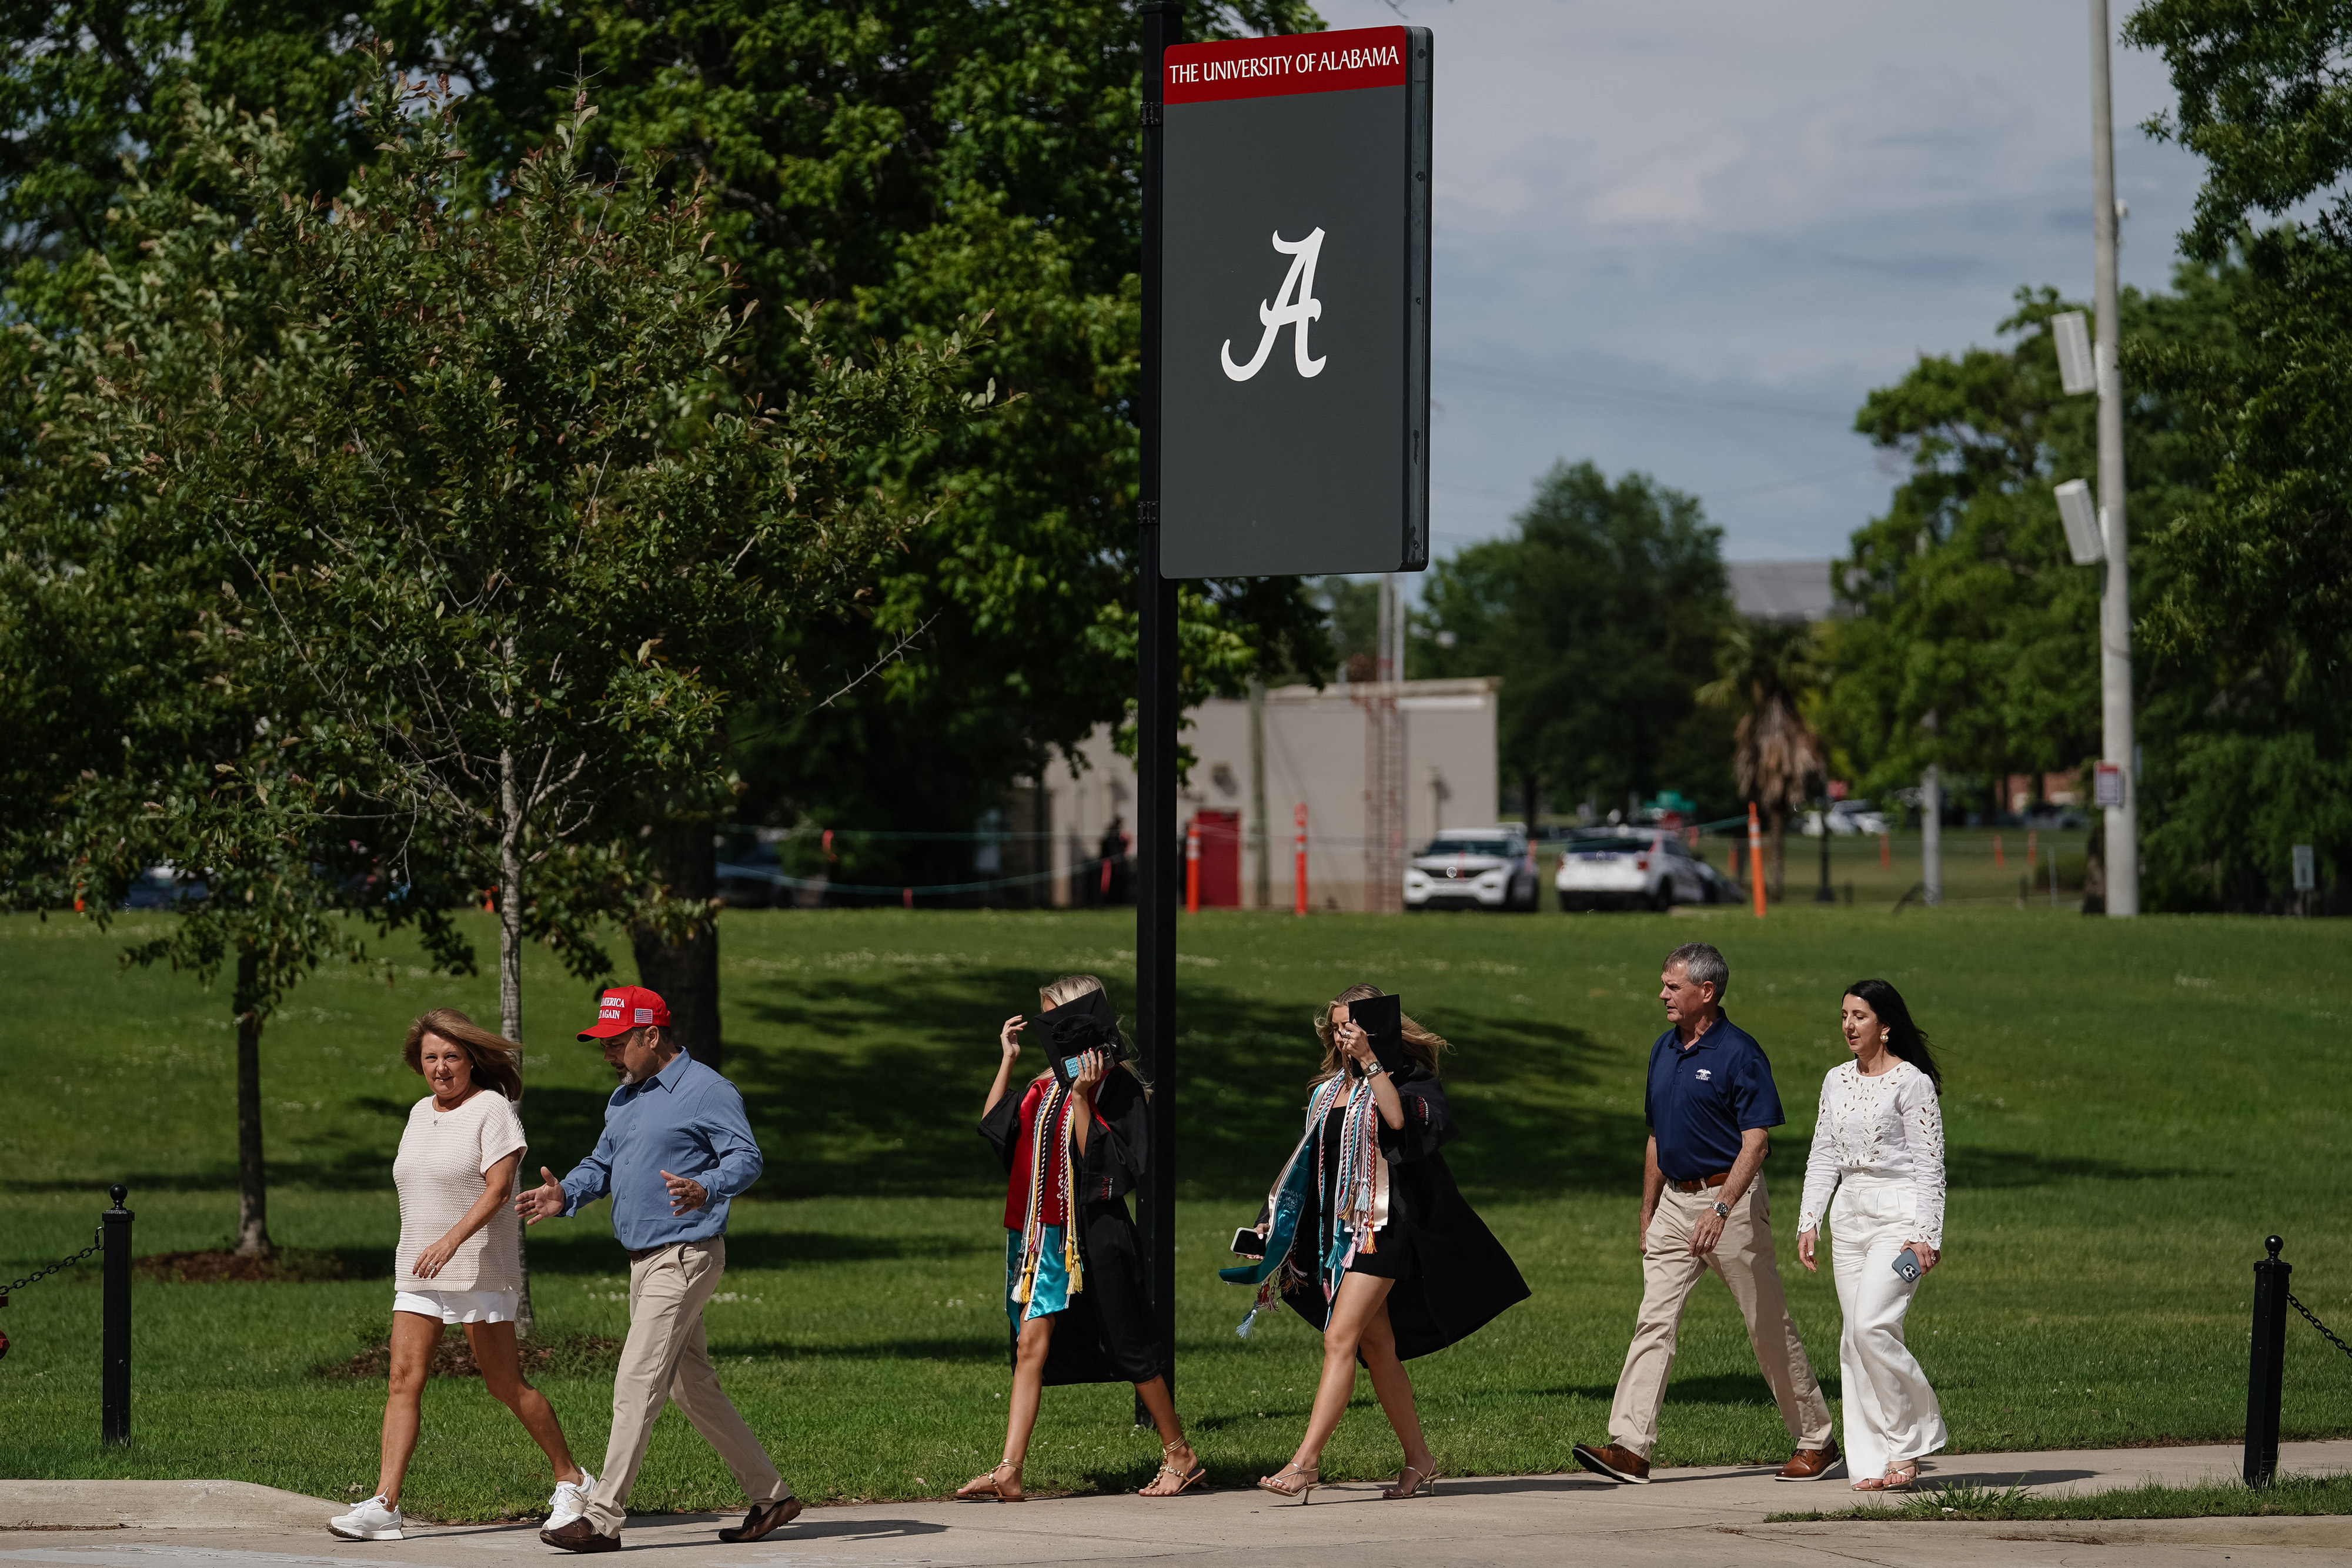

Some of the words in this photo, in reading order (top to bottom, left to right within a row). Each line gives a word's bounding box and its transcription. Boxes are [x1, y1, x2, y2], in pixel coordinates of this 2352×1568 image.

[1170, 64, 1199, 83] THE
[1204, 55, 1293, 81] UNIVERSITY
[1296, 53, 1317, 73] OF
[1318, 46, 1399, 71] ALABAMA
[1221, 226, 1327, 382] A
[600, 997, 624, 1008] AMERICA
[602, 1009, 620, 1019] AGAIN
